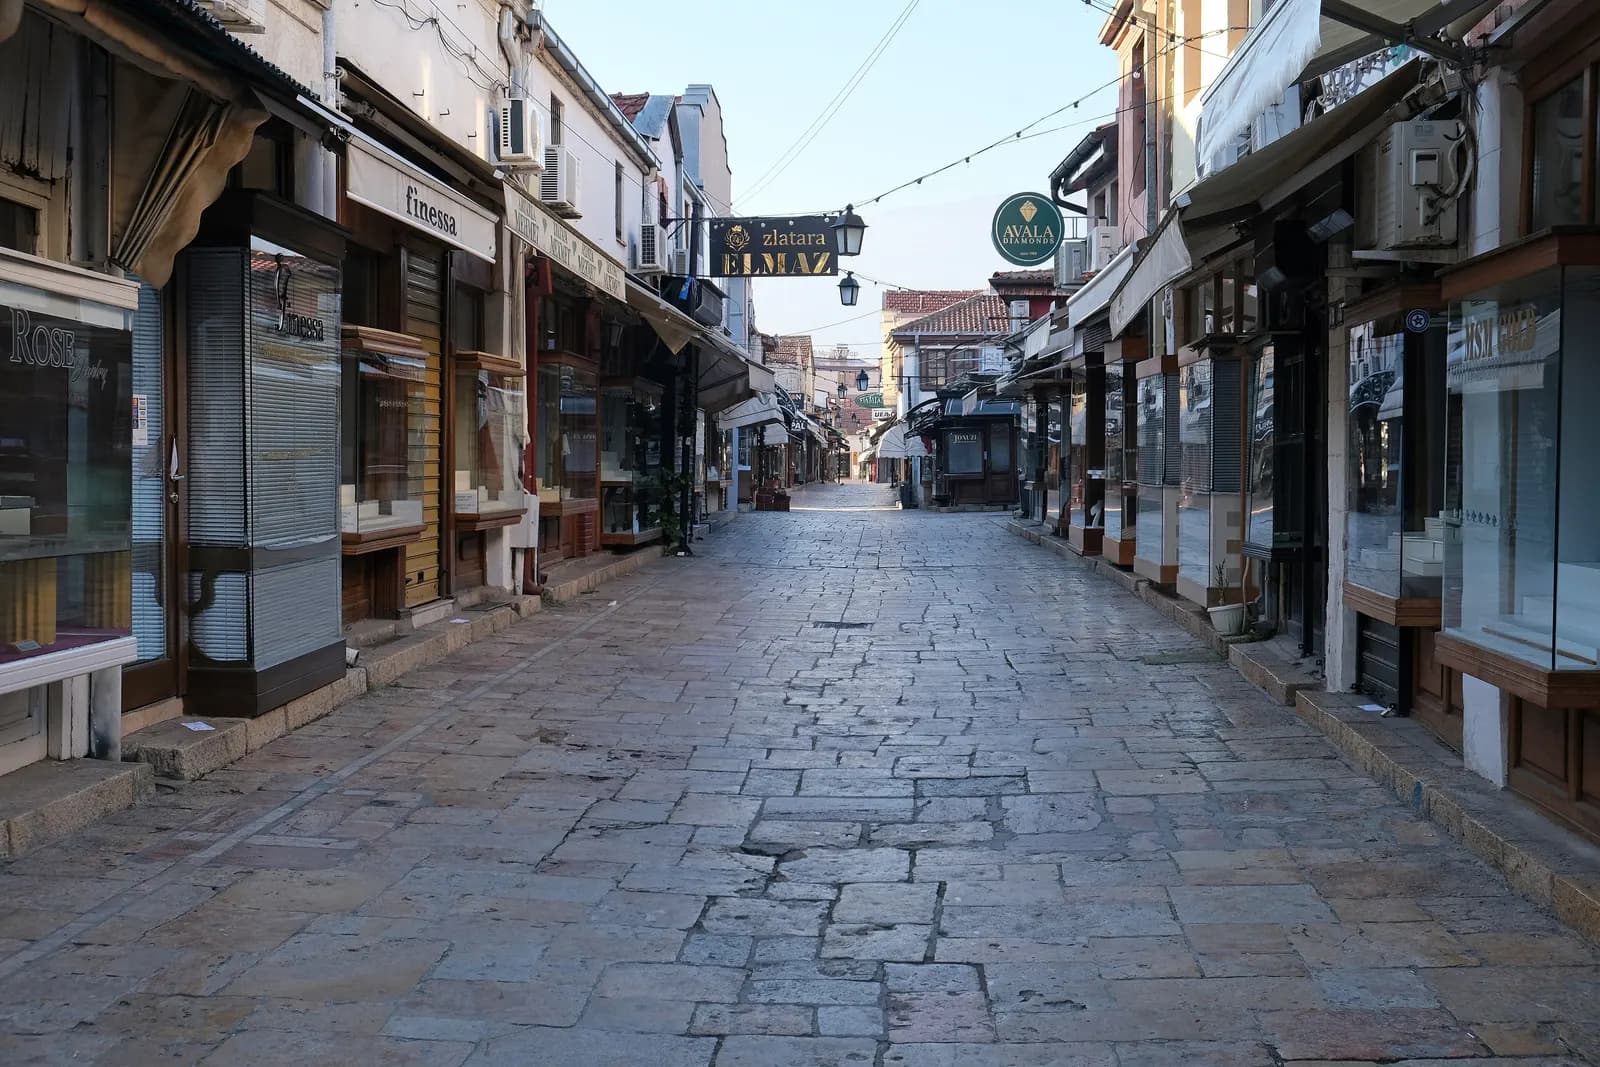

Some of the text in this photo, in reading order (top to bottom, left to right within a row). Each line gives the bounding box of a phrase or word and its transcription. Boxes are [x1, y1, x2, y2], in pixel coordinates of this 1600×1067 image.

[405, 185, 457, 237] finessa
[762, 229, 825, 246] zlatara
[1003, 225, 1054, 238] AVALA
[720, 252, 832, 275] ELMAZ
